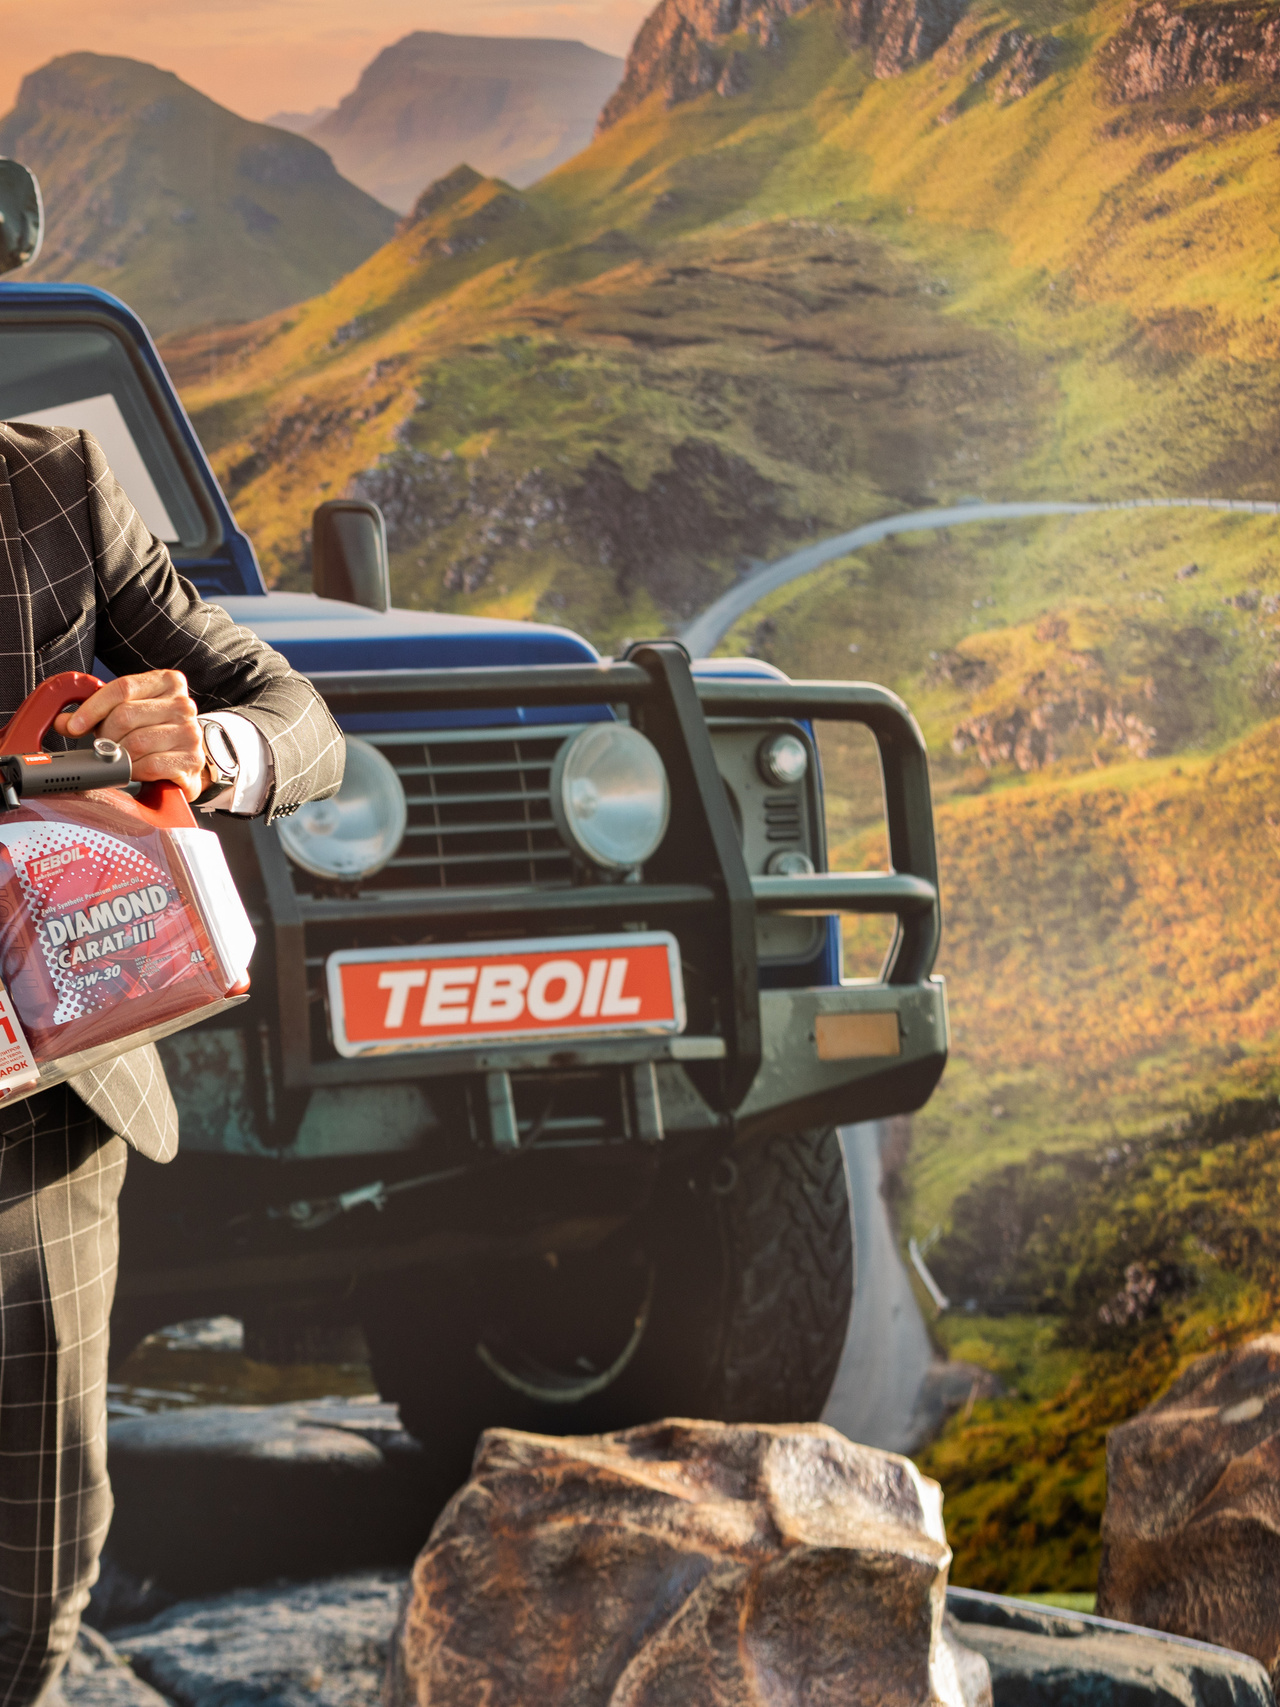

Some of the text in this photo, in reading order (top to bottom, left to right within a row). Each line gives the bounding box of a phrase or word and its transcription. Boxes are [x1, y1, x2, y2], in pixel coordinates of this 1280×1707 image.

[30, 847, 85, 875] TEBOIL
[34, 868, 64, 882] Lubricants
[41, 876, 140, 918] Fully Synthetic Premium Motor Oil
[46, 884, 168, 947] DIAMOND
[58, 931, 124, 968] CARAT
[132, 921, 155, 944] III
[191, 949, 205, 963] 4L
[76, 964, 120, 990] 5W-30
[378, 958, 641, 1028] TEBOIL
